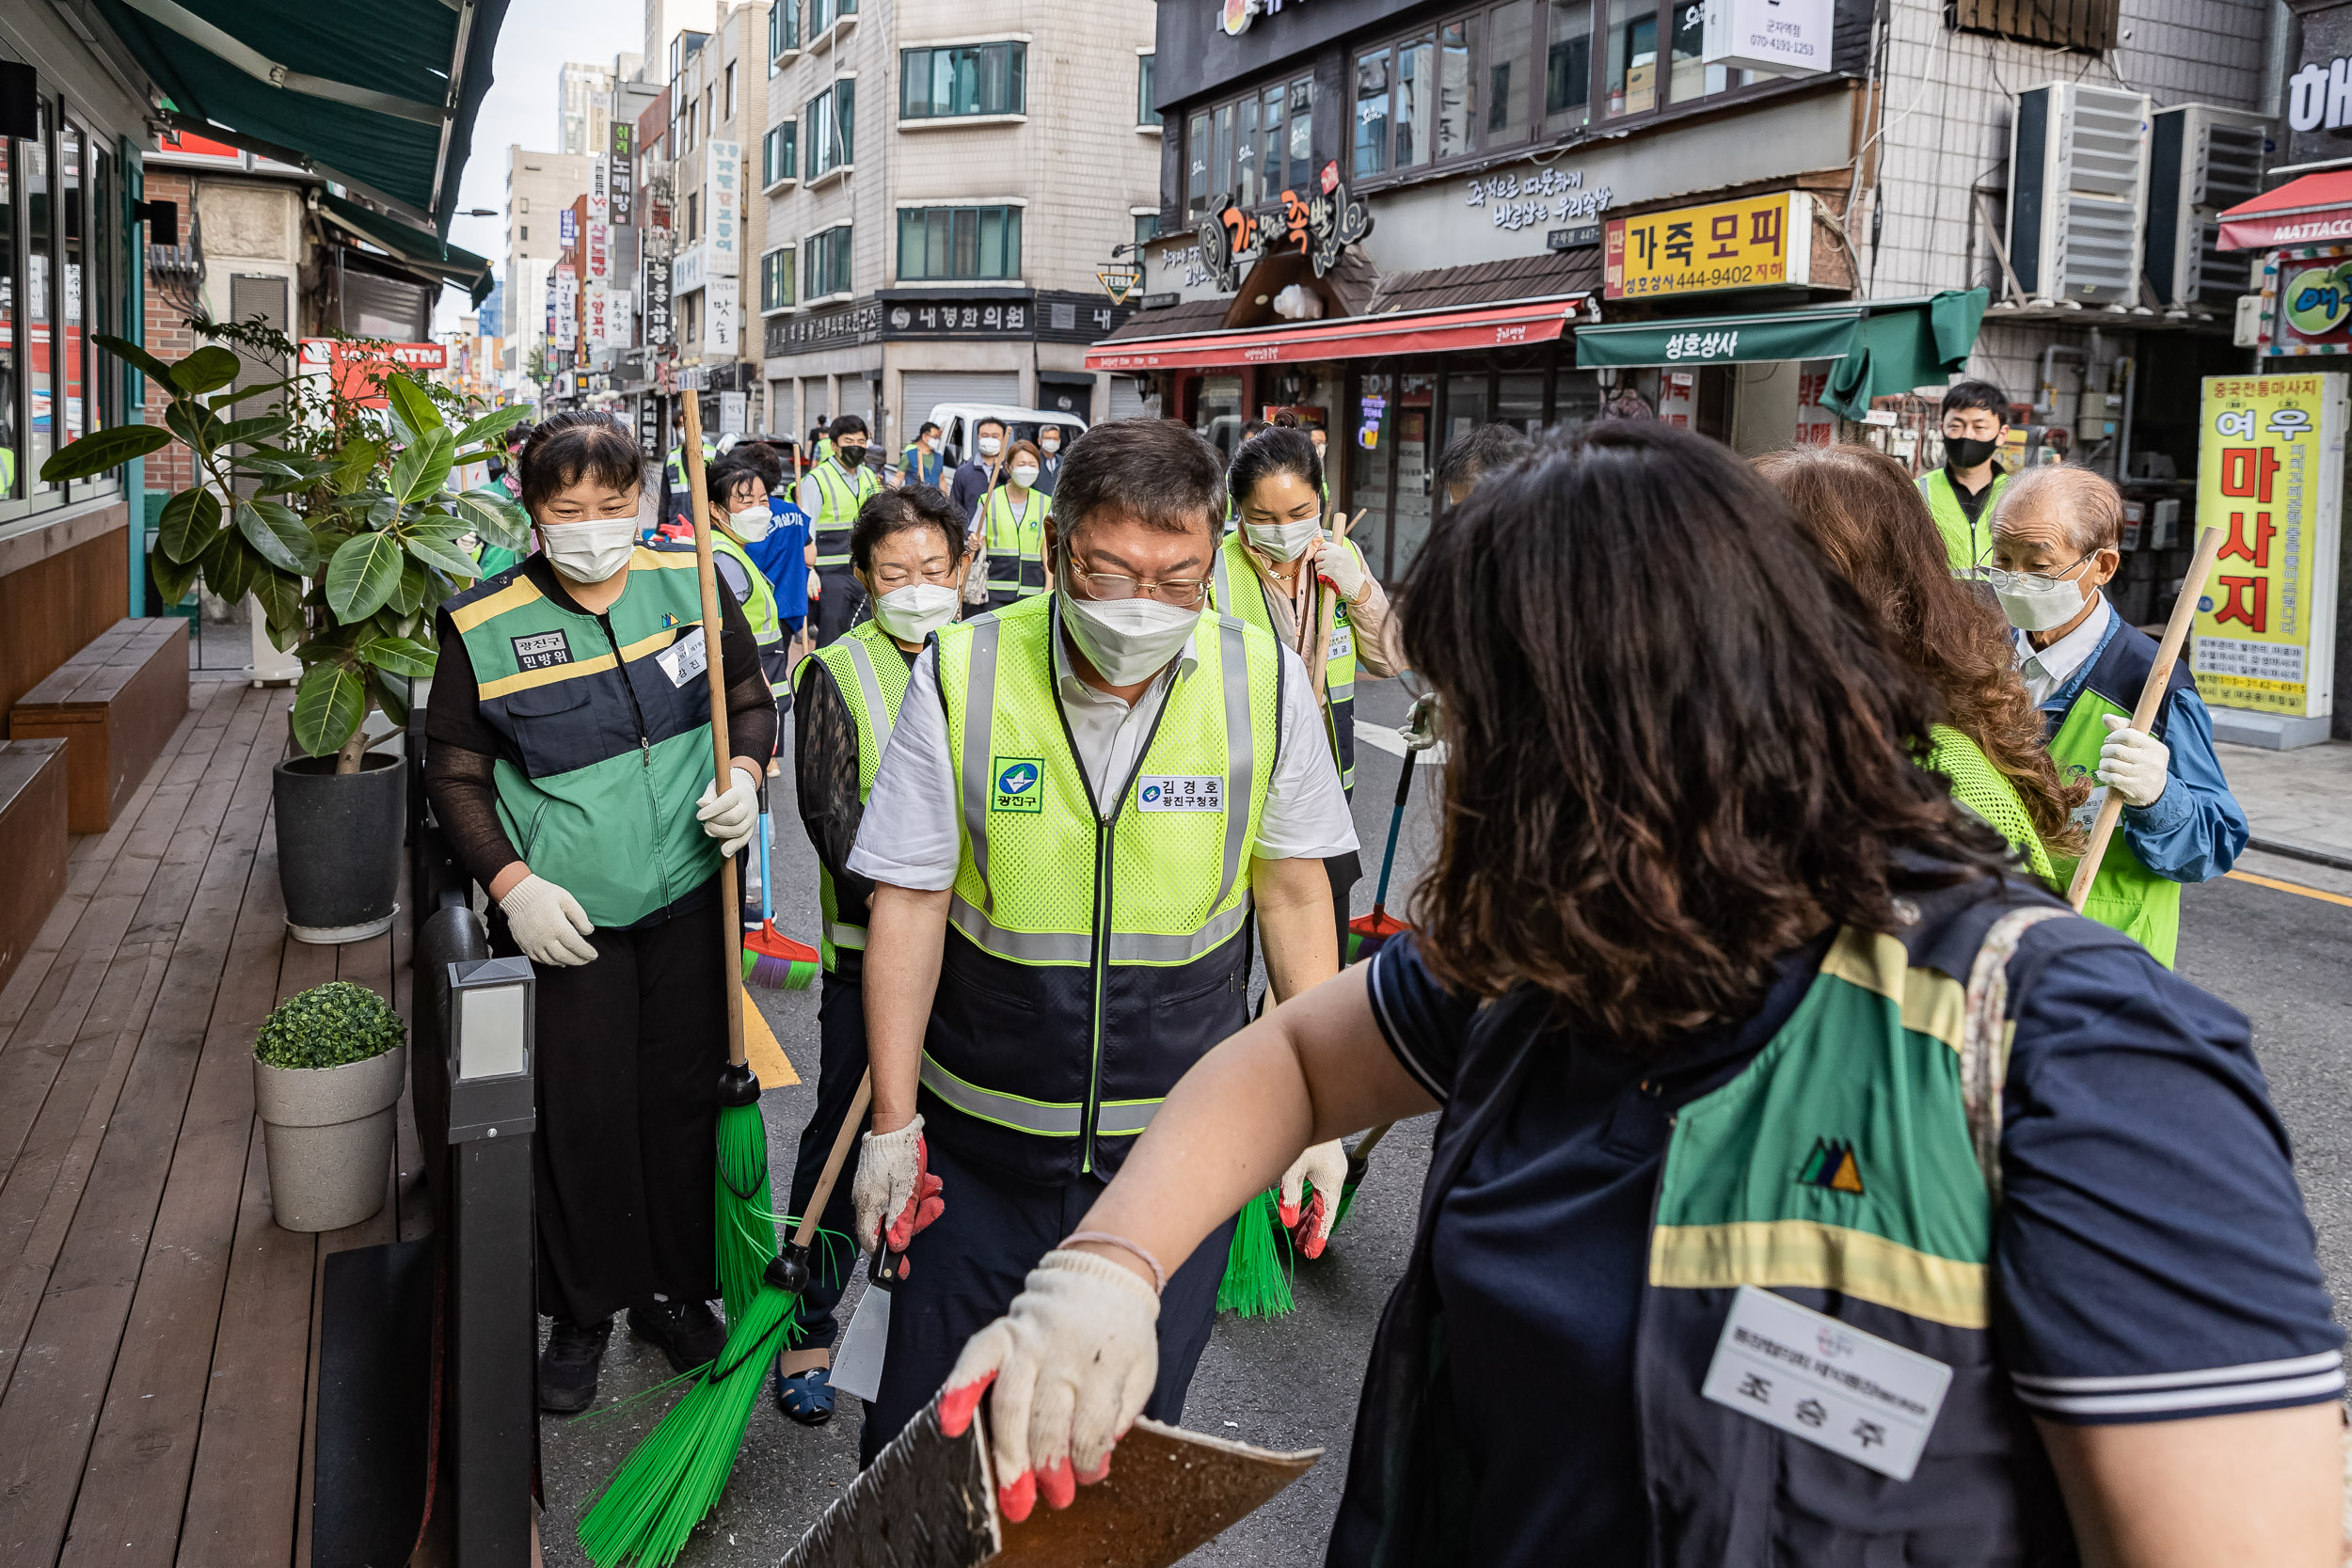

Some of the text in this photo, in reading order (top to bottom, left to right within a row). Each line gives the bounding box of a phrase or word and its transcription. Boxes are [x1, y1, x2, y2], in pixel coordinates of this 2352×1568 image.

[1630, 206, 1783, 270] 가죽 모피
[1104, 276, 1134, 287] TERRA
[1625, 261, 1783, 294] 성호상사 444-9402 지하
[919, 306, 1025, 330] 내경한의원
[1665, 330, 1739, 359] 성호상사
[392, 348, 442, 364] ATM
[2216, 408, 2313, 441] 여우
[2215, 447, 2280, 633] 마사지
[518, 637, 562, 651] 광진구
[522, 650, 568, 670] 민방위
[1162, 781, 1218, 794] 김경호
[996, 796, 1037, 807] 광진구
[1162, 796, 1219, 808] 광진구청장
